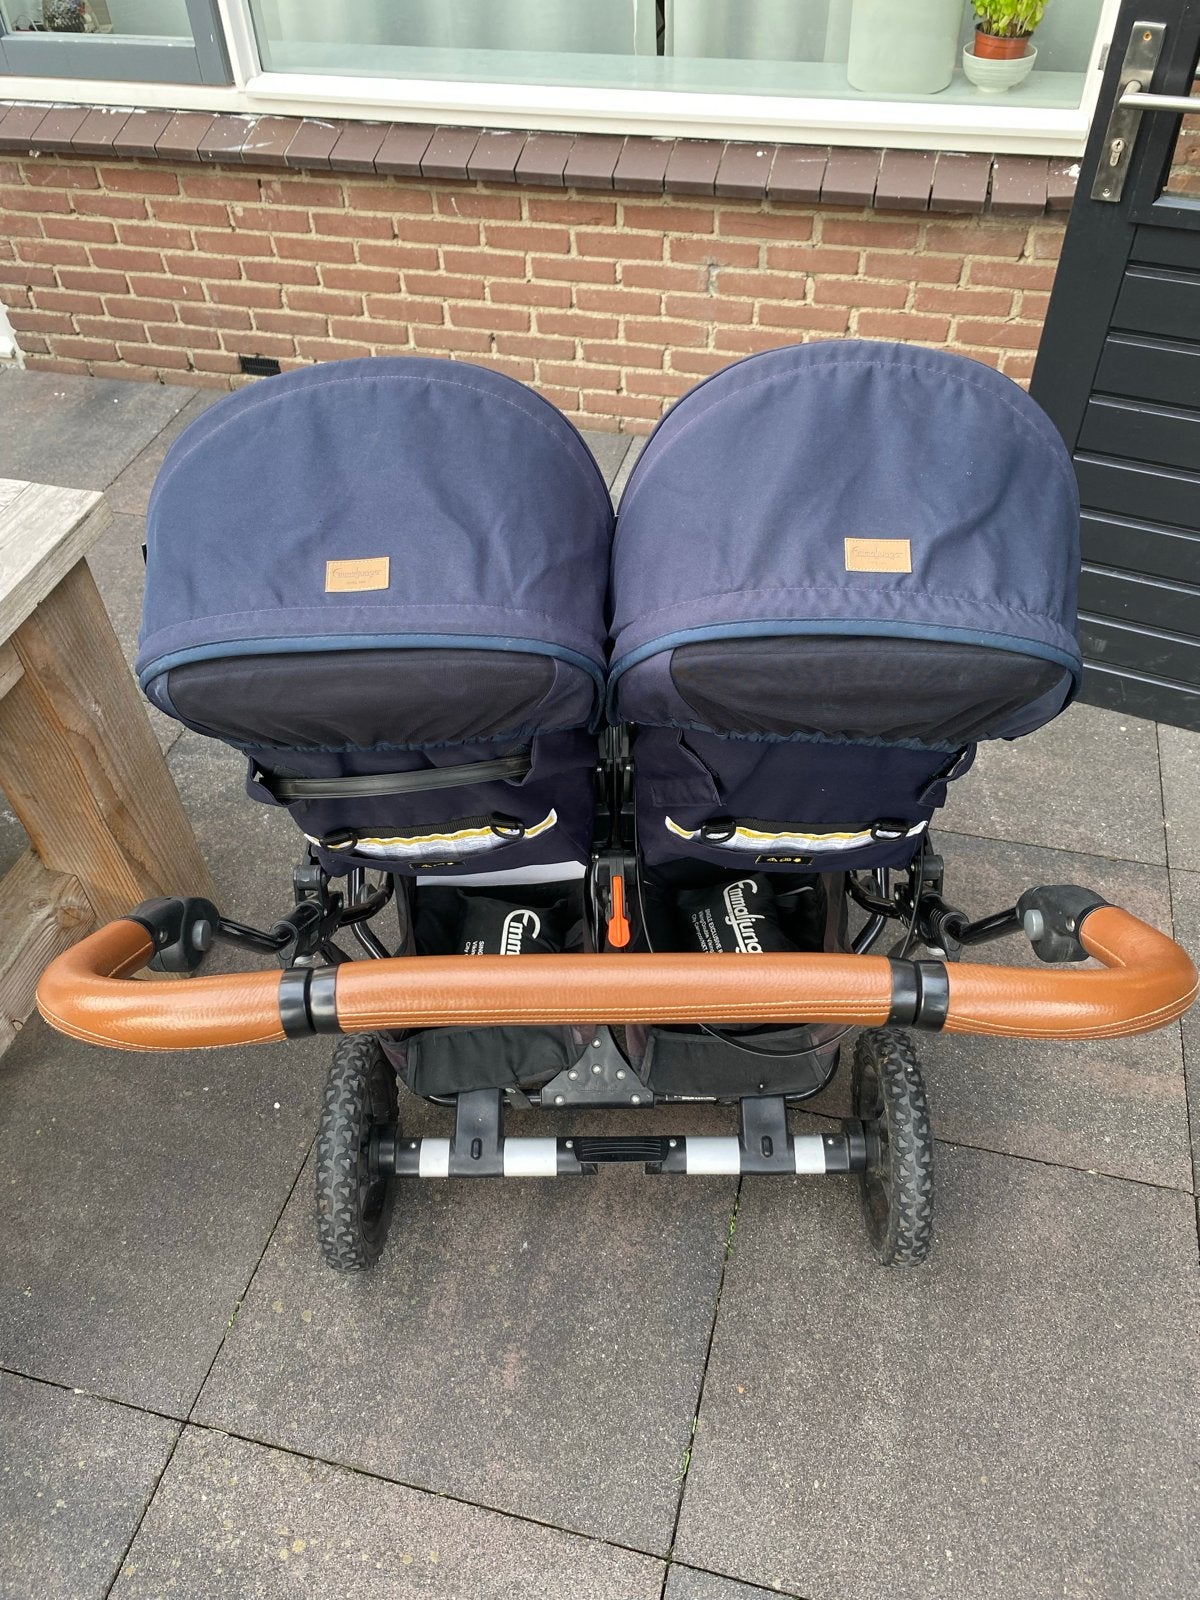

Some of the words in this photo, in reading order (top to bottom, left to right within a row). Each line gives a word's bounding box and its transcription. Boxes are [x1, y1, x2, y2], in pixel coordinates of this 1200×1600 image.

[500, 909, 541, 955] Emm
[723, 879, 766, 953] Emmaljung
[477, 940, 485, 955] SING
